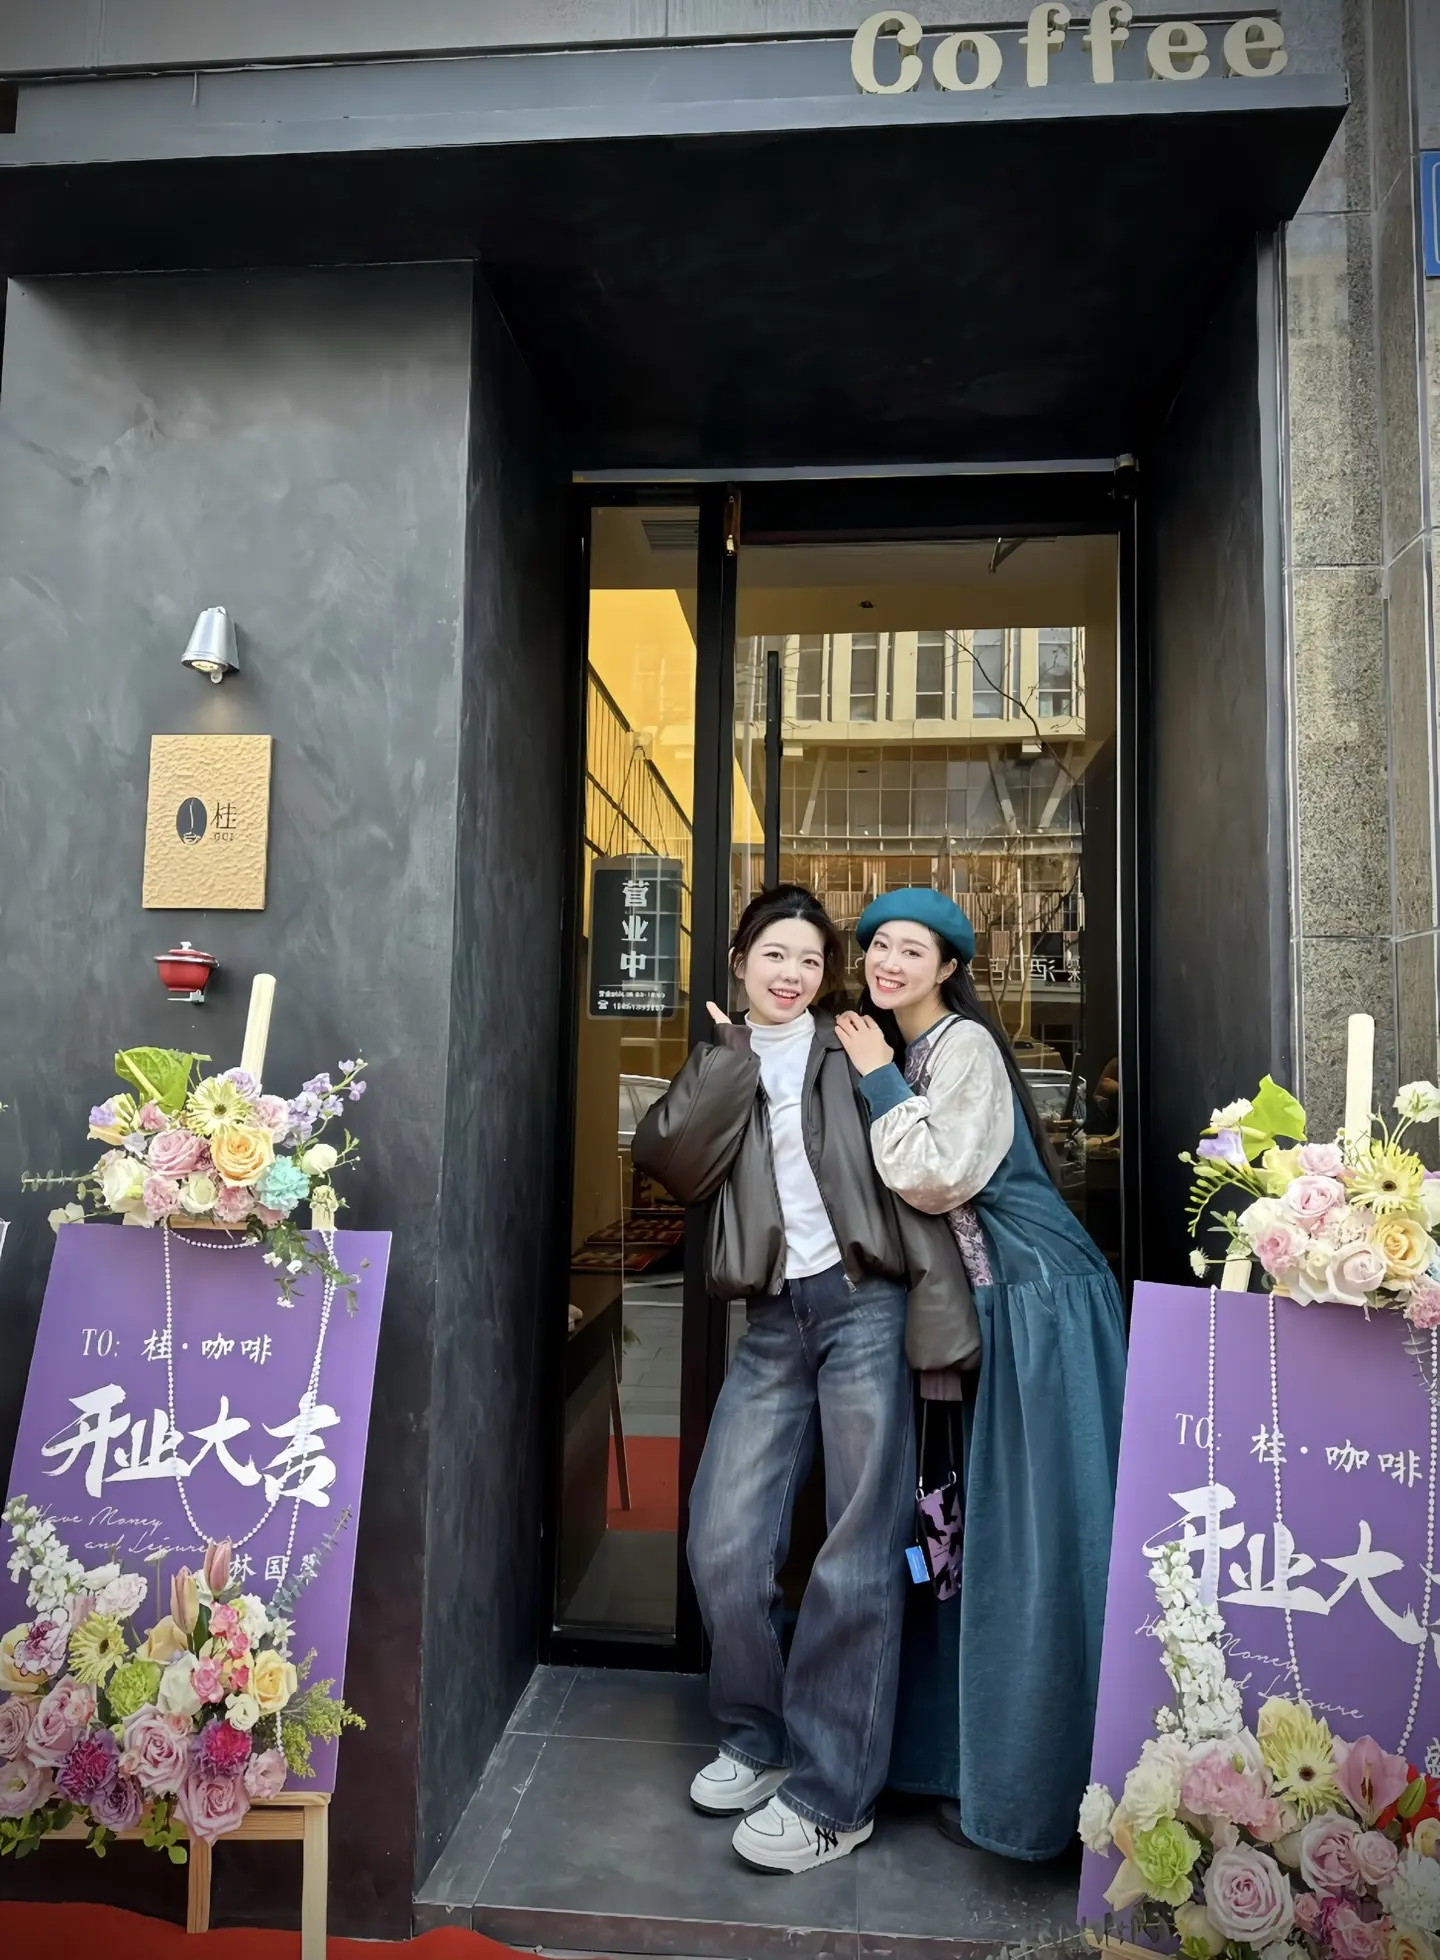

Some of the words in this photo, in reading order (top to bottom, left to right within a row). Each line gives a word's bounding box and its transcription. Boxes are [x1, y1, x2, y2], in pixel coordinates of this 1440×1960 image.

[851, 0, 1288, 94] Coffee
[210, 802, 237, 829] 桂
[619, 879, 650, 978] 营业中
[81, 1328, 121, 1358] TO:
[41, 1383, 341, 1508] 开业大吉
[1175, 1412, 1223, 1451] TO:
[88, 1506, 163, 1537] Money
[1141, 1482, 1440, 1670] 开业大
